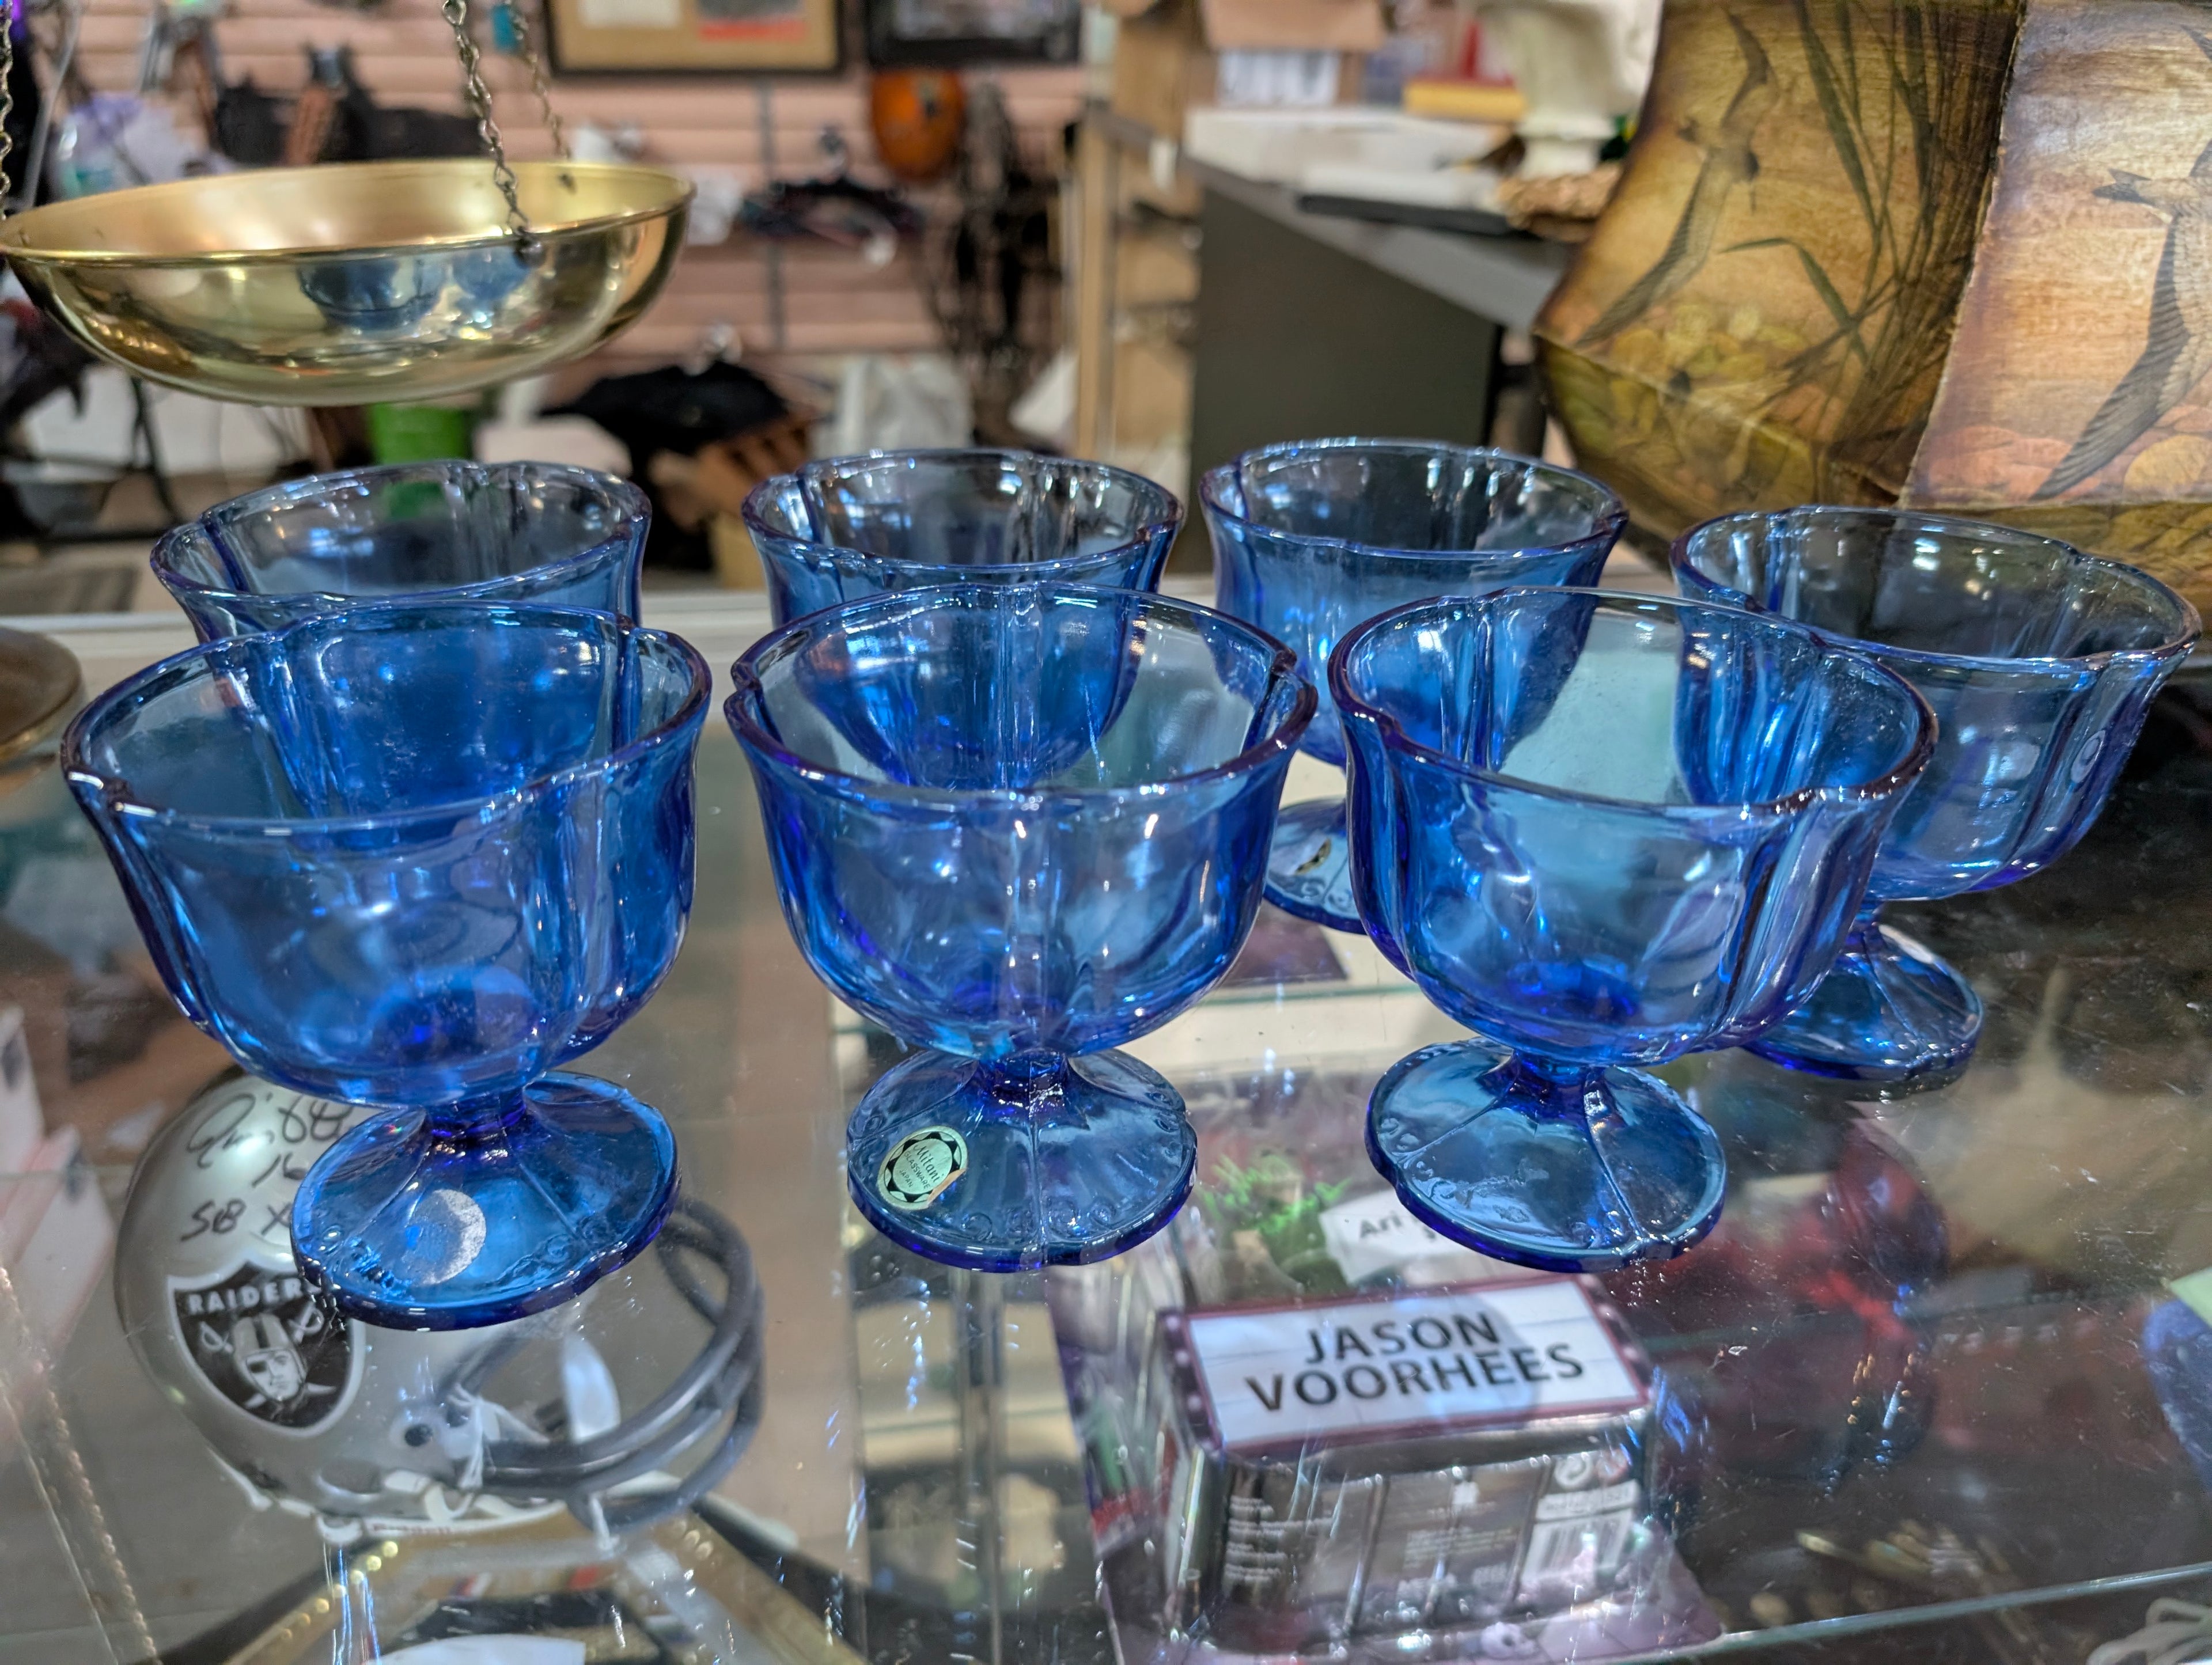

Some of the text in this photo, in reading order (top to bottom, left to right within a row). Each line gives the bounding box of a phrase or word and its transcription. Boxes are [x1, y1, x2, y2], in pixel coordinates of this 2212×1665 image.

[899, 1169, 914, 1188] JAPAN
[903, 1151, 930, 1189] GLASSWARE
[913, 1144, 944, 1182] Mitani
[1305, 1311, 1499, 1364] JASON
[1245, 1342, 1584, 1411] VOORHEES
